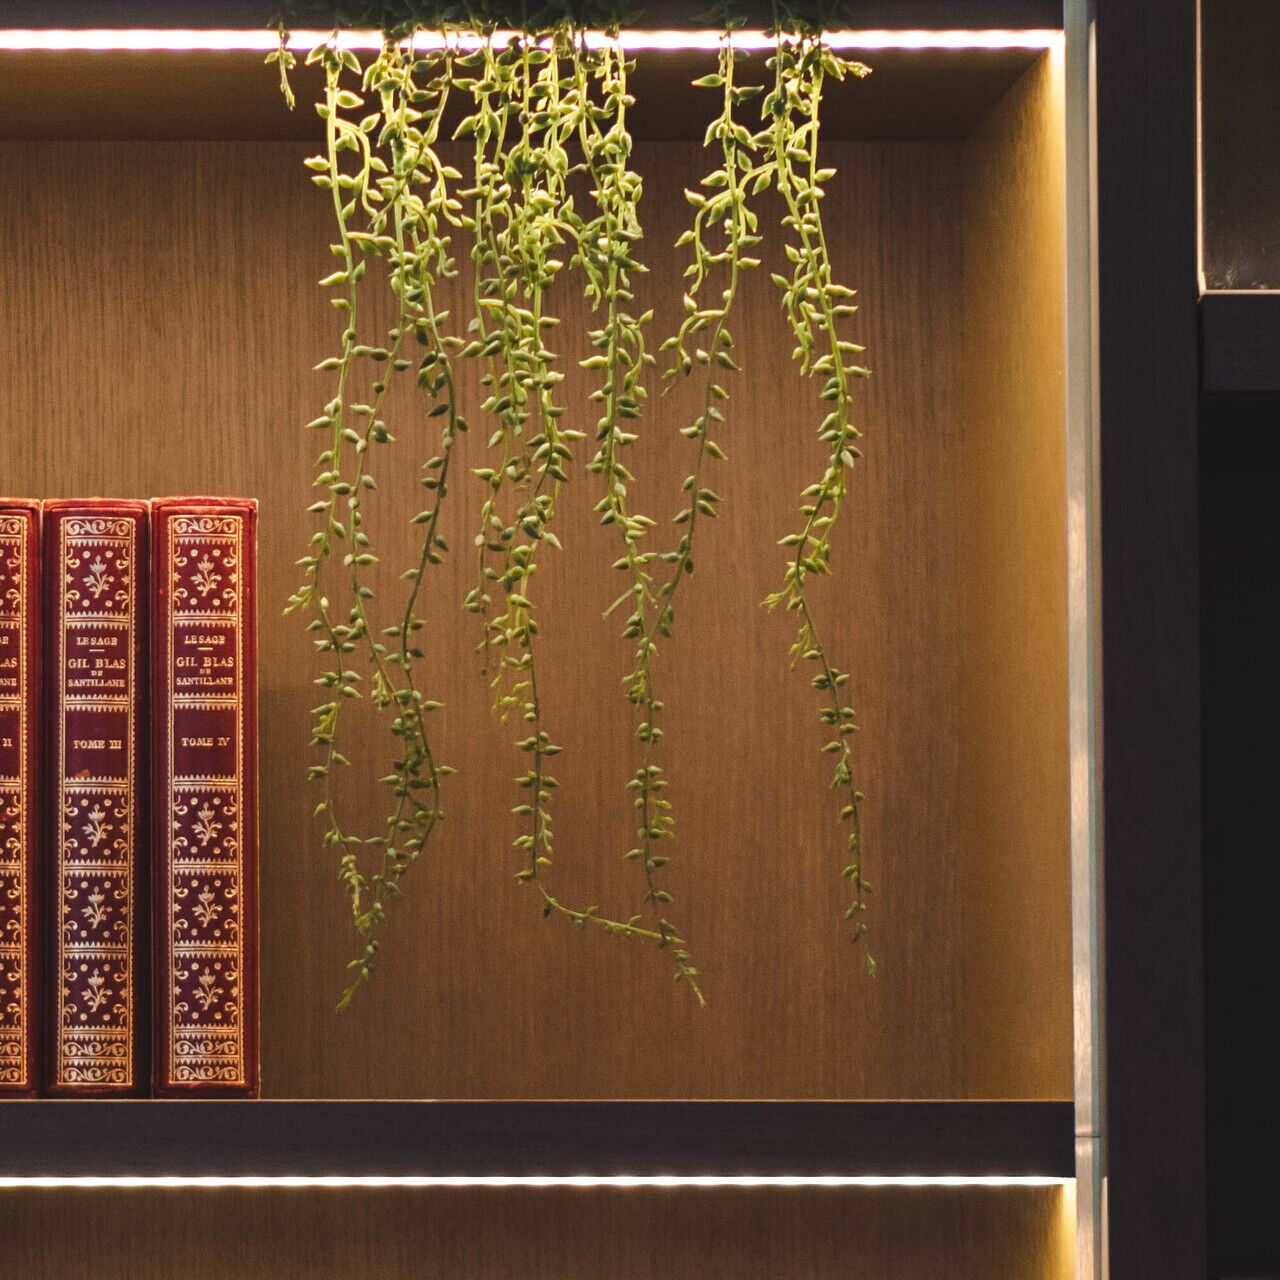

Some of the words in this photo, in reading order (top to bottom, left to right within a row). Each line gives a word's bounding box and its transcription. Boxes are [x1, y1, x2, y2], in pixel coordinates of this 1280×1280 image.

[68, 658, 90, 669] GIL
[95, 658, 126, 669] BLAS
[176, 656, 198, 667] GIL
[203, 656, 234, 667] BLAS
[68, 679, 125, 687] SANTILLANE
[176, 677, 234, 686] SANTILLANE
[2, 738, 12, 747] II
[73, 740, 105, 749] TOME
[109, 739, 122, 749] III
[181, 737, 214, 747] TOME
[218, 737, 230, 747] IV
